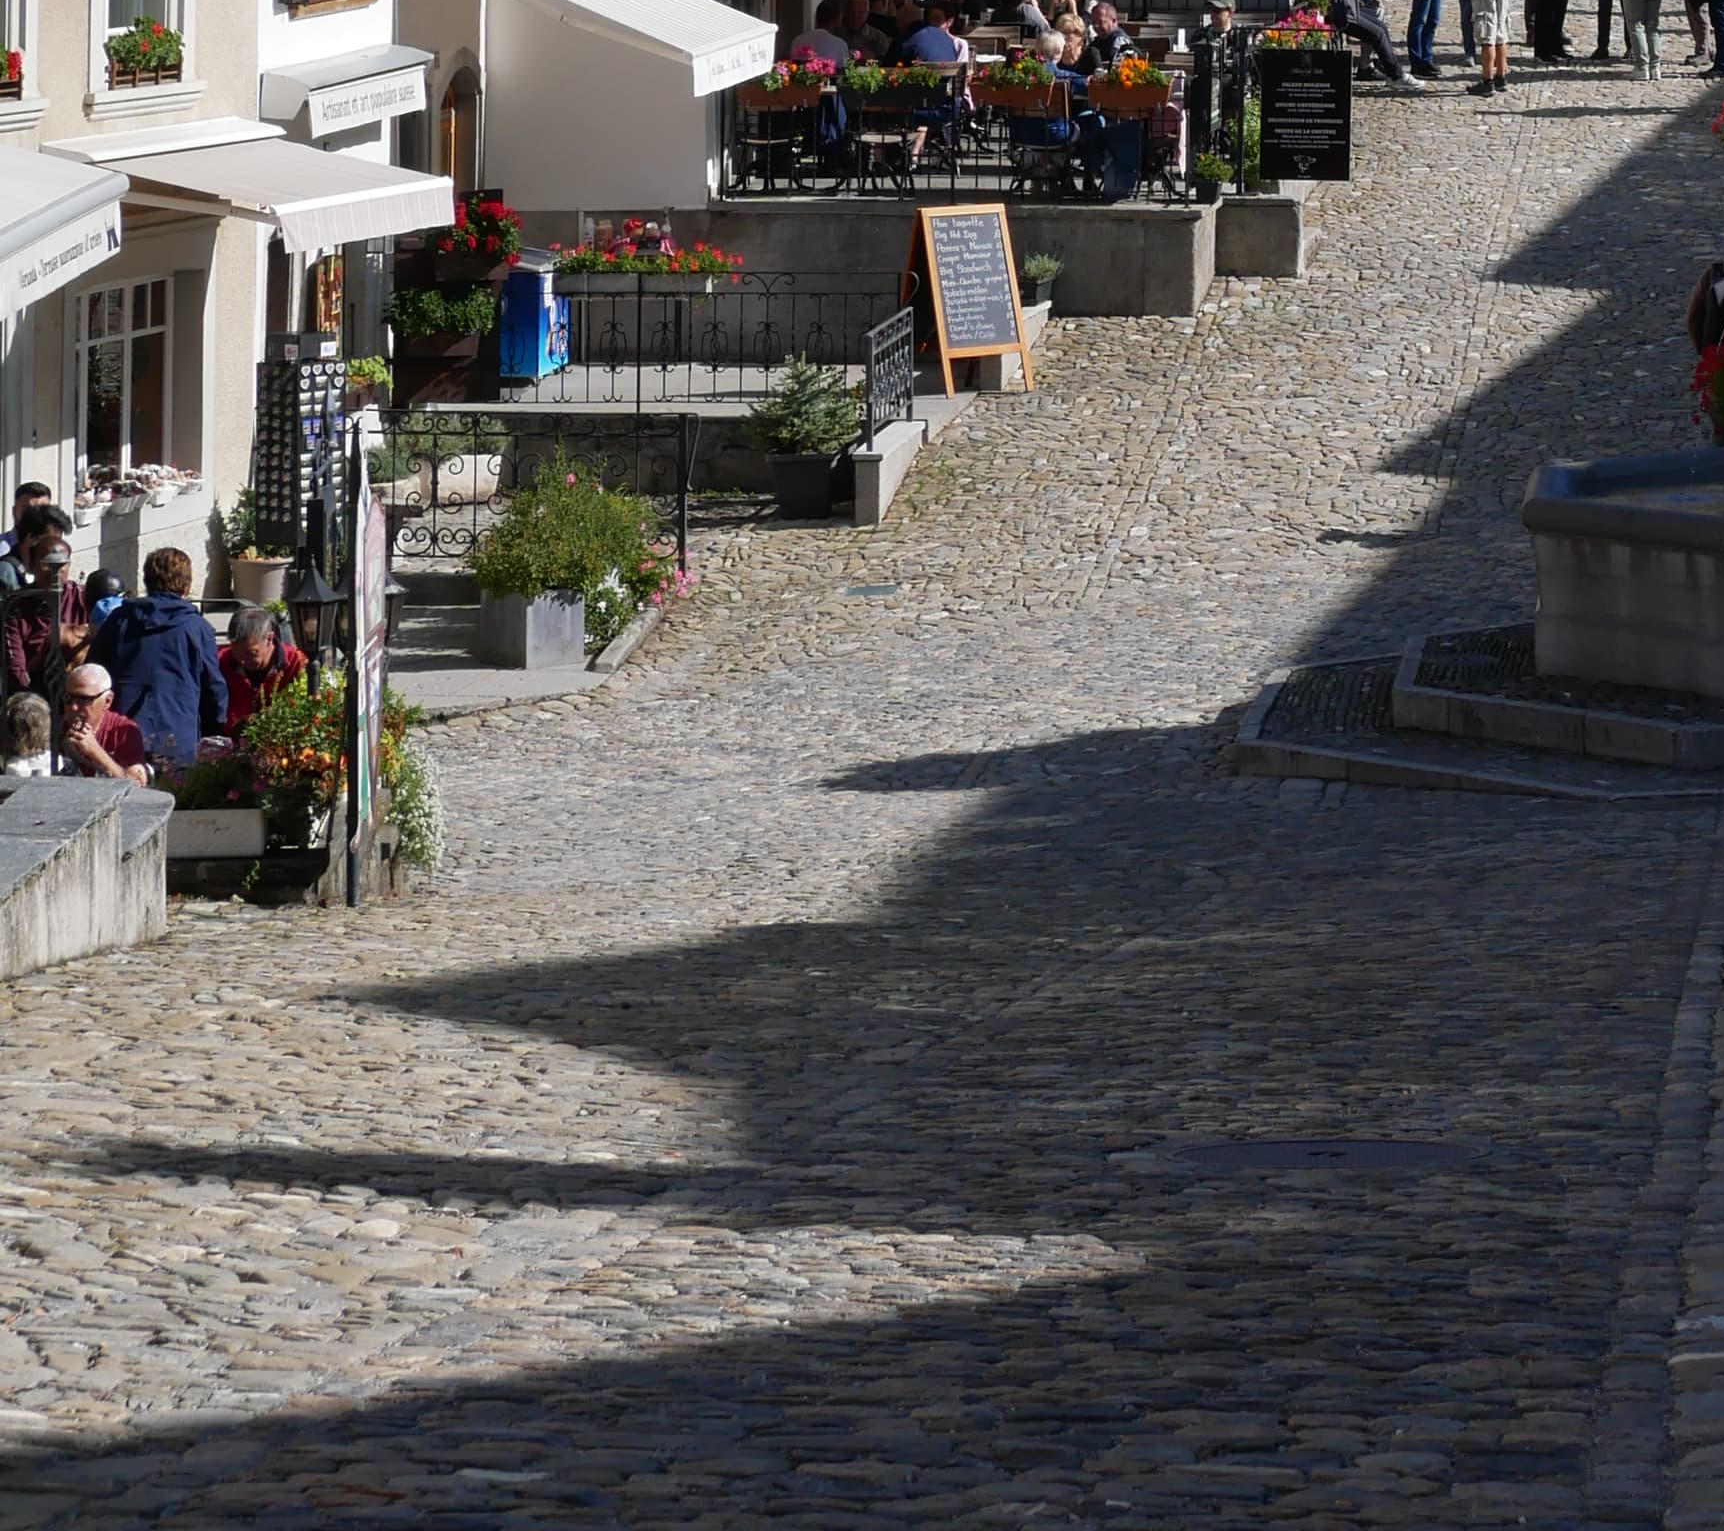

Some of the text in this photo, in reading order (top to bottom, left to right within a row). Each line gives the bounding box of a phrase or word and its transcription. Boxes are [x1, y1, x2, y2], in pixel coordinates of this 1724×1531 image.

[321, 80, 416, 122] Artisanat et art populaire suisse
